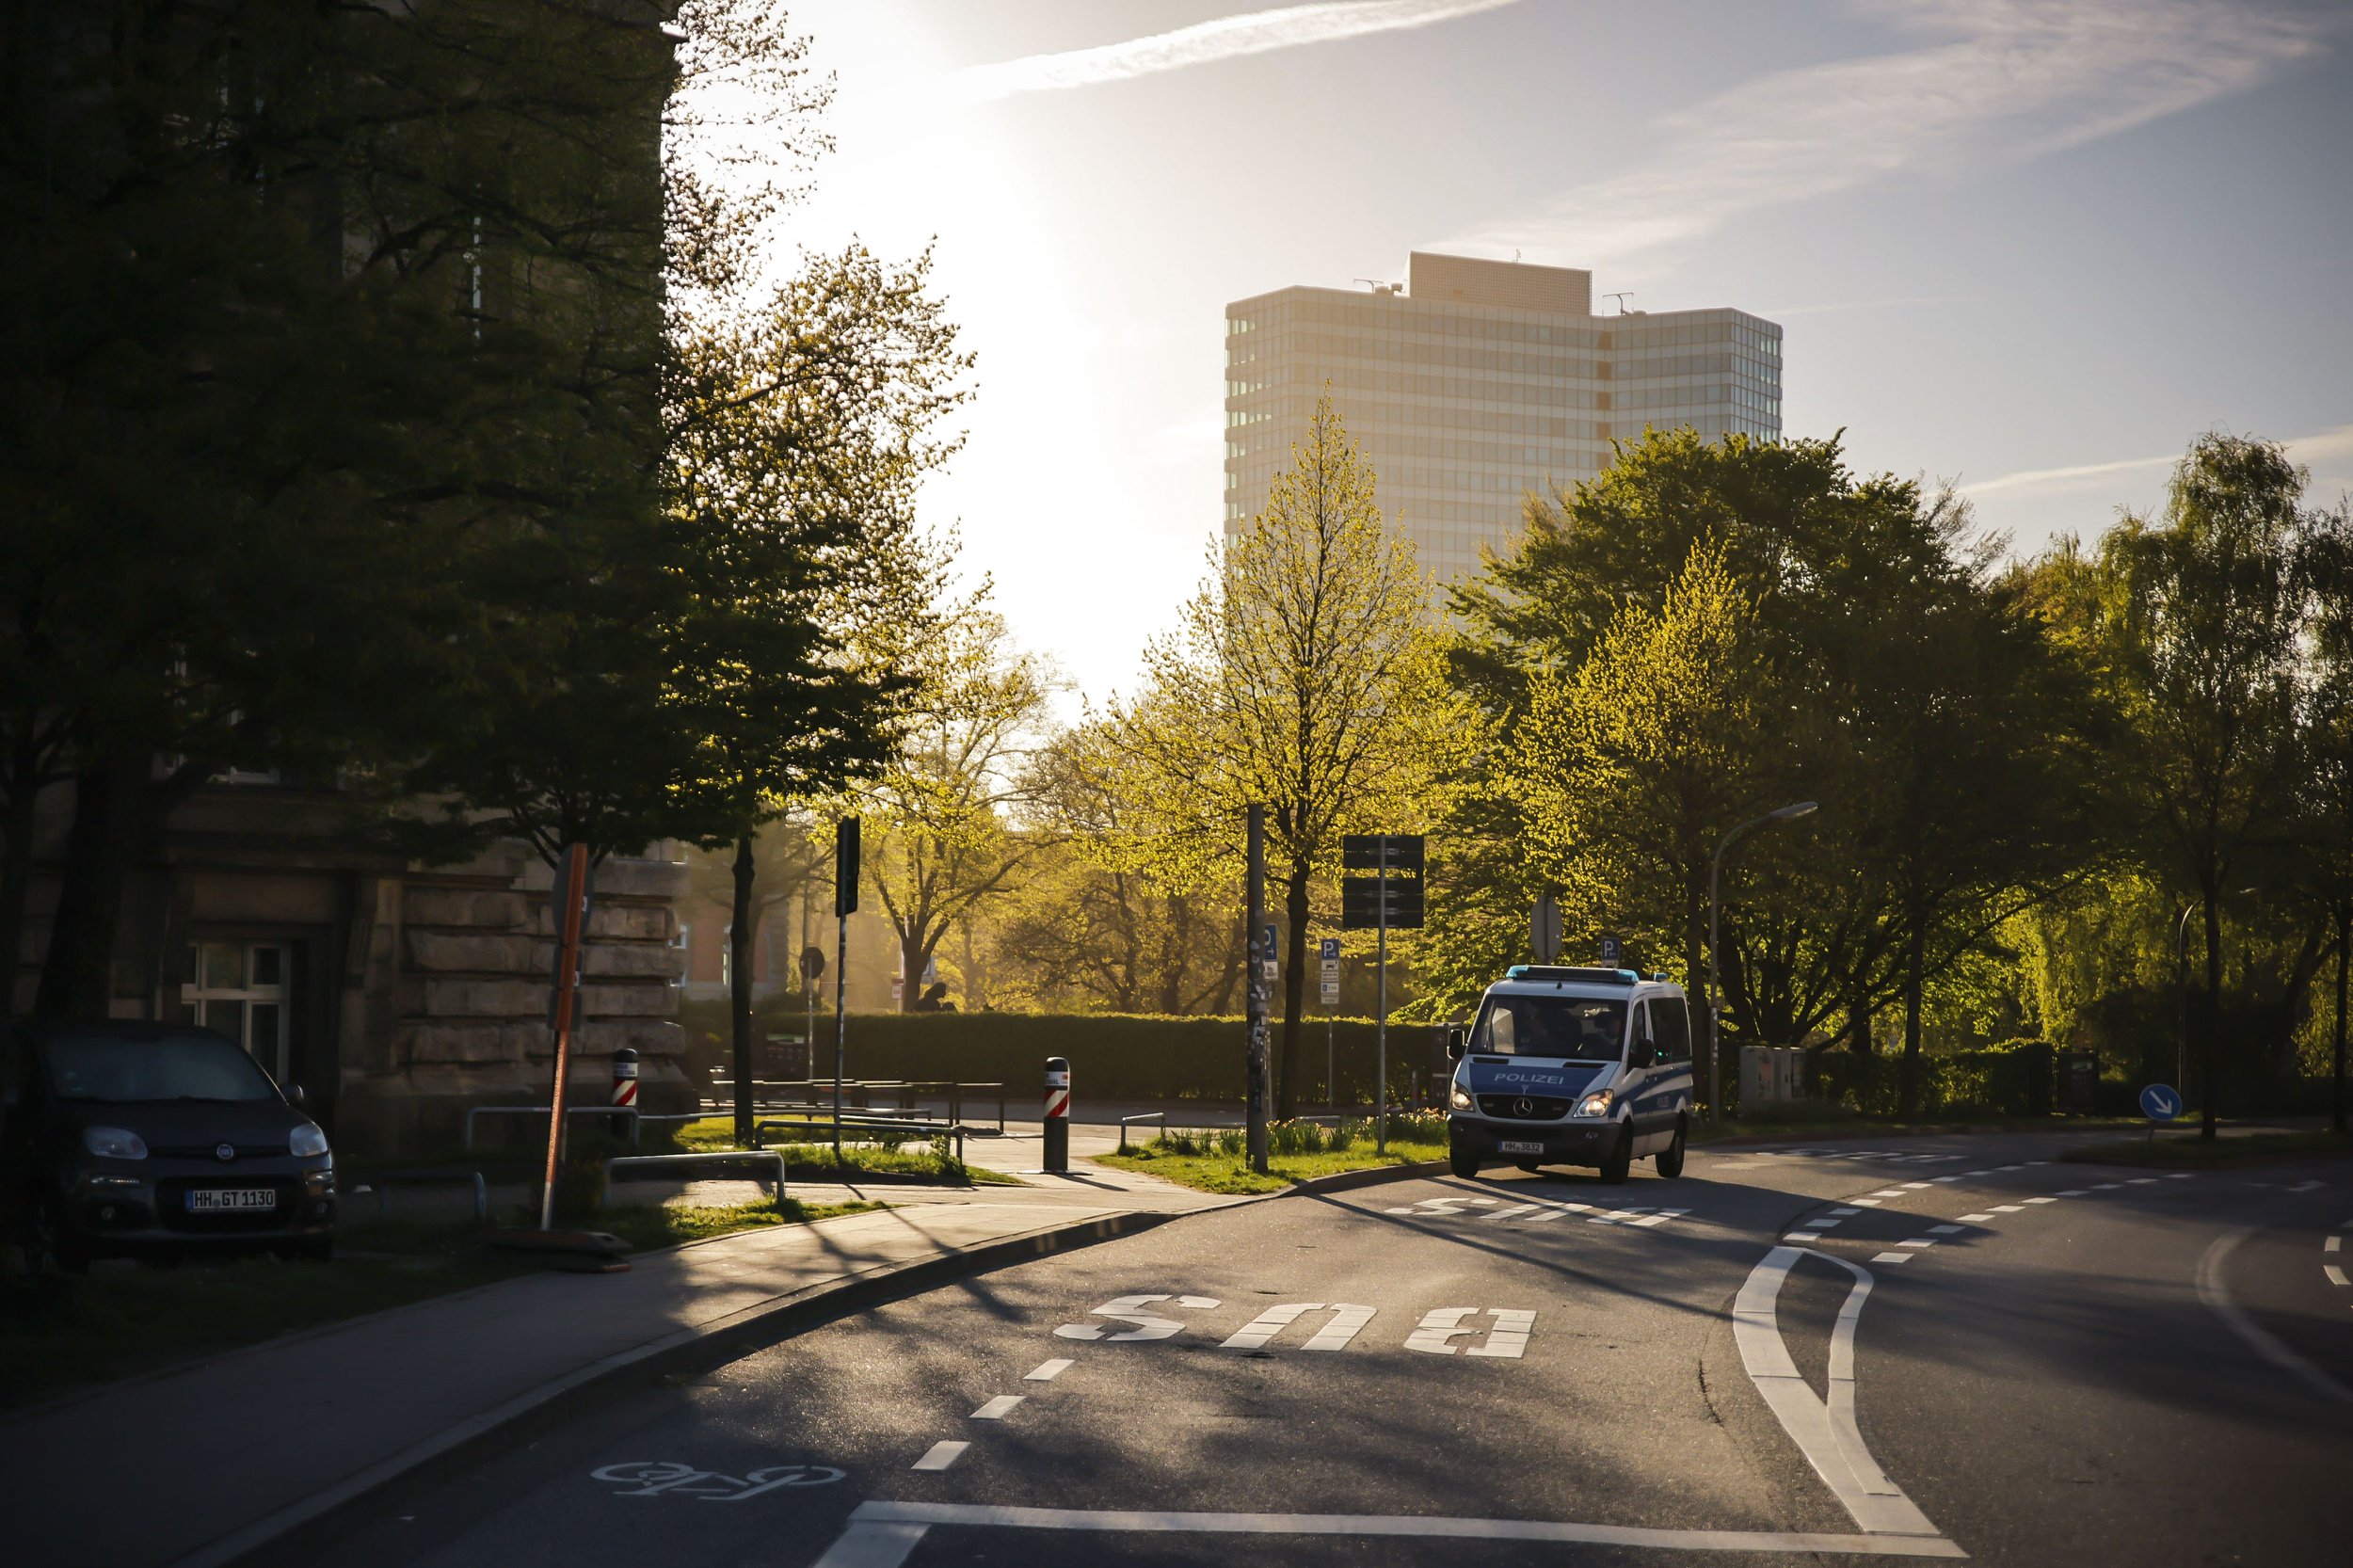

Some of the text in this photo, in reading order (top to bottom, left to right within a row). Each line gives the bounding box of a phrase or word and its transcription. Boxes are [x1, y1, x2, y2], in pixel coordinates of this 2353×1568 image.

[1323, 941, 1334, 957] P
[1604, 940, 1614, 957] P
[1494, 1073, 1564, 1084] POLIZEI
[195, 1192, 274, 1207] HH GT 1130
[1384, 1197, 1693, 1226] BUS
[1052, 1294, 1538, 1359] BUS
